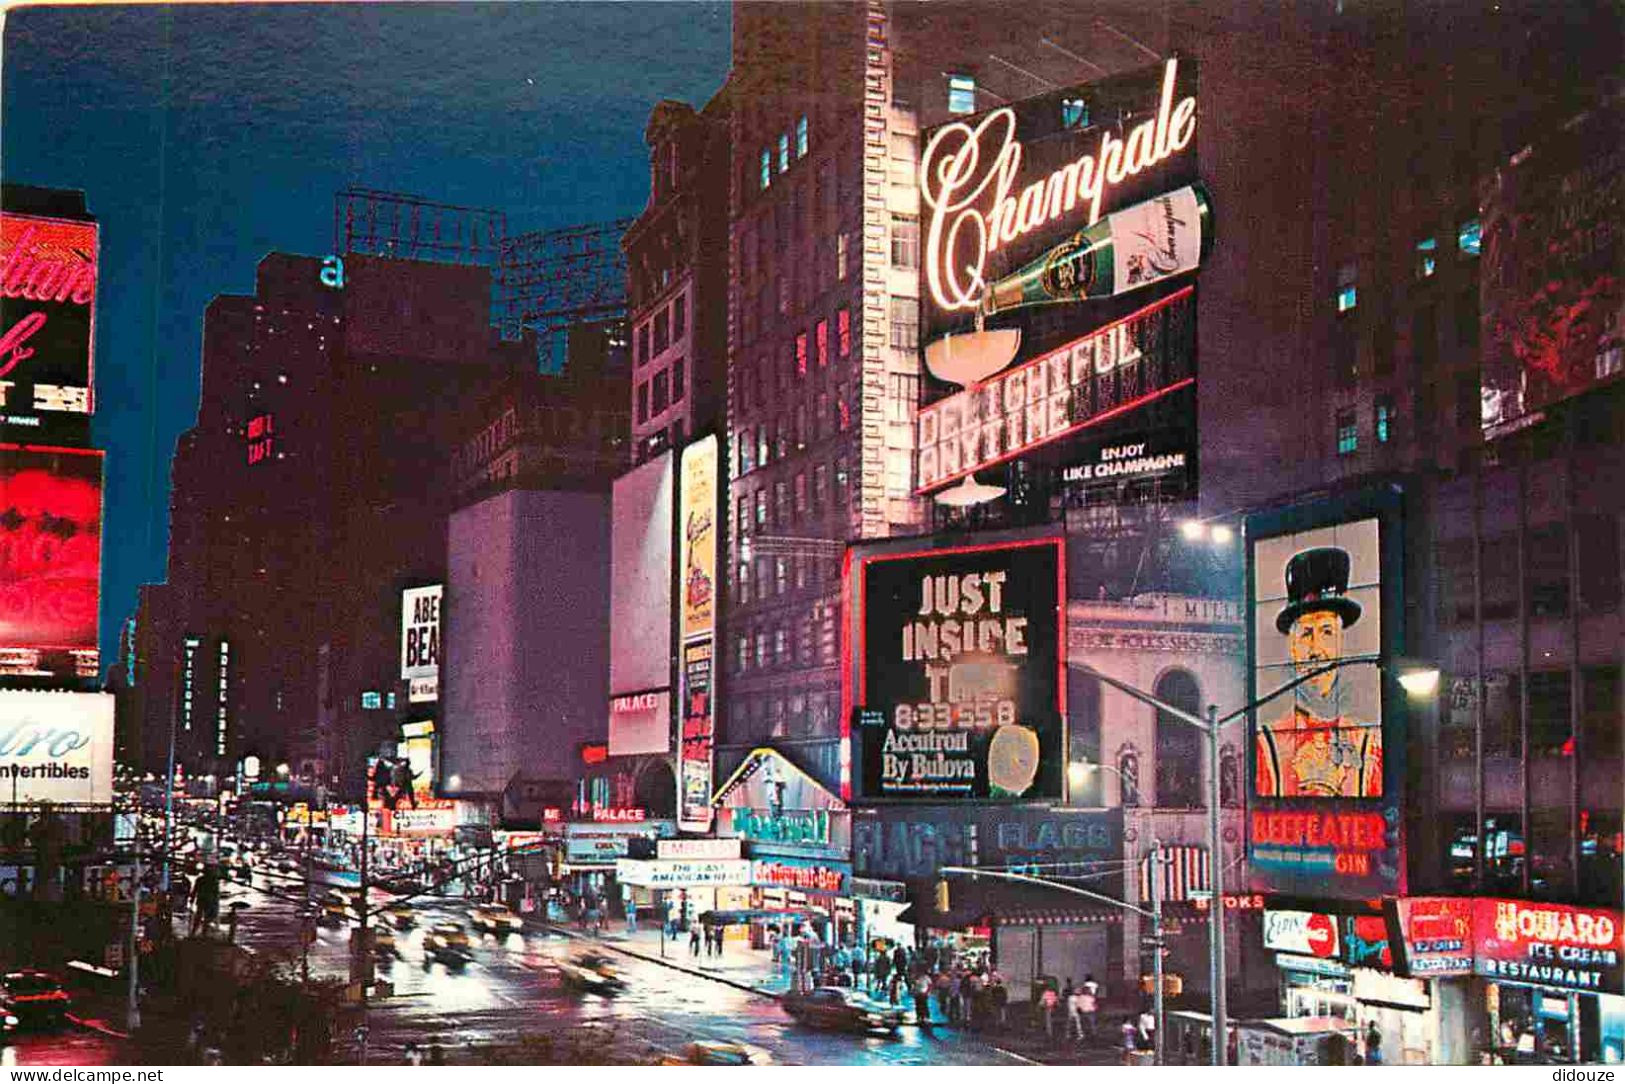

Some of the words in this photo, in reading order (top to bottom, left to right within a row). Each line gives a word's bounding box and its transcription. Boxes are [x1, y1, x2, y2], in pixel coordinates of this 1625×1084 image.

[921, 58, 1196, 311] Champale
[320, 255, 344, 289] a
[1101, 443, 1145, 460] ENJOY
[1063, 465, 1093, 481] LIKE
[1095, 454, 1185, 477] CHAMPAGNE
[918, 570, 1006, 615] JUST
[414, 597, 438, 625] ABE
[902, 617, 1028, 661] INSIDE
[184, 649, 194, 730] VICTORIA
[614, 695, 658, 713] PALACE
[883, 728, 968, 752] Accutron
[883, 753, 909, 782] By
[911, 753, 974, 779] Bulova
[593, 808, 646, 821] PALACE
[1252, 811, 1387, 849] BEEFEATER
[1335, 853, 1369, 876] GIN
[1195, 895, 1265, 911] BOKS
[1495, 901, 1614, 946] HOWARD
[1529, 942, 1554, 959] ICE
[1559, 946, 1617, 964] CREAM
[1486, 959, 1602, 987] RESTAURANT
